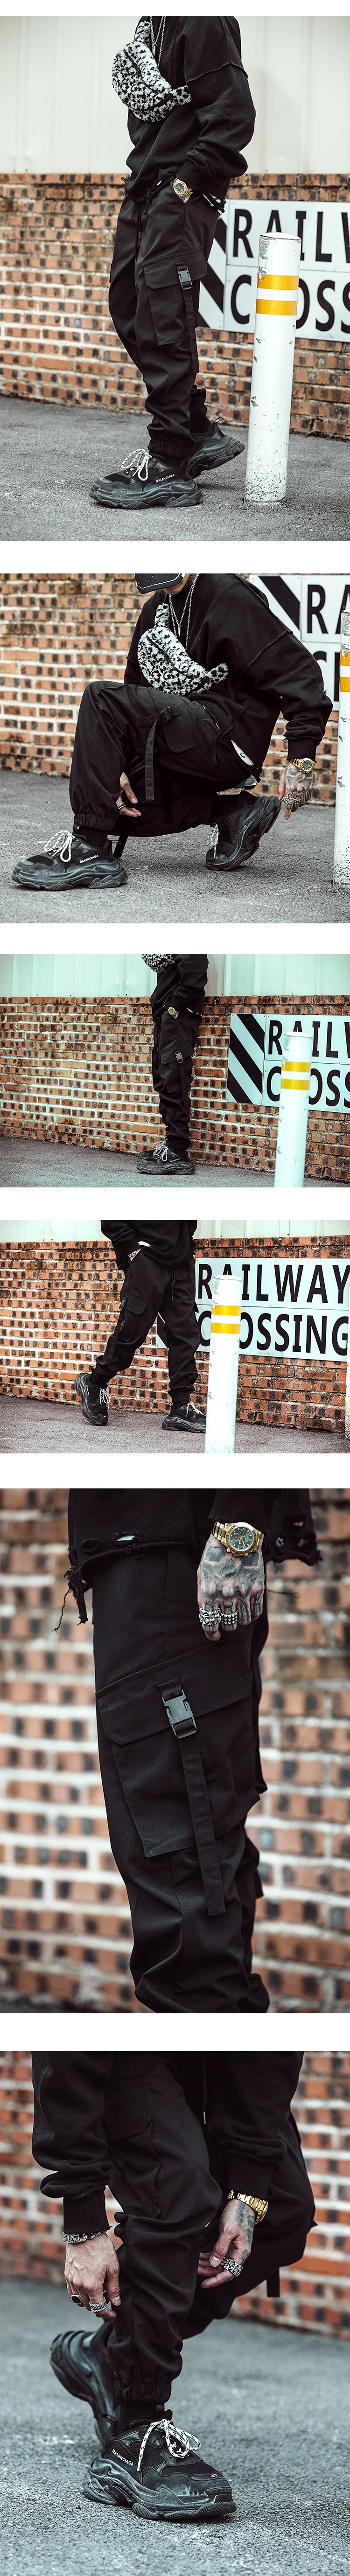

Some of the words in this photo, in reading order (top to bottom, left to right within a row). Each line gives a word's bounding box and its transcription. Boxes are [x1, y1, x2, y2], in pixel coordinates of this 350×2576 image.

[156, 474, 175, 482] BALENCIAGA
[79, 854, 99, 864] BALENCIAGA
[198, 1310, 349, 1356] COSSING
[112, 2449, 133, 2466] BALENCIAGA
